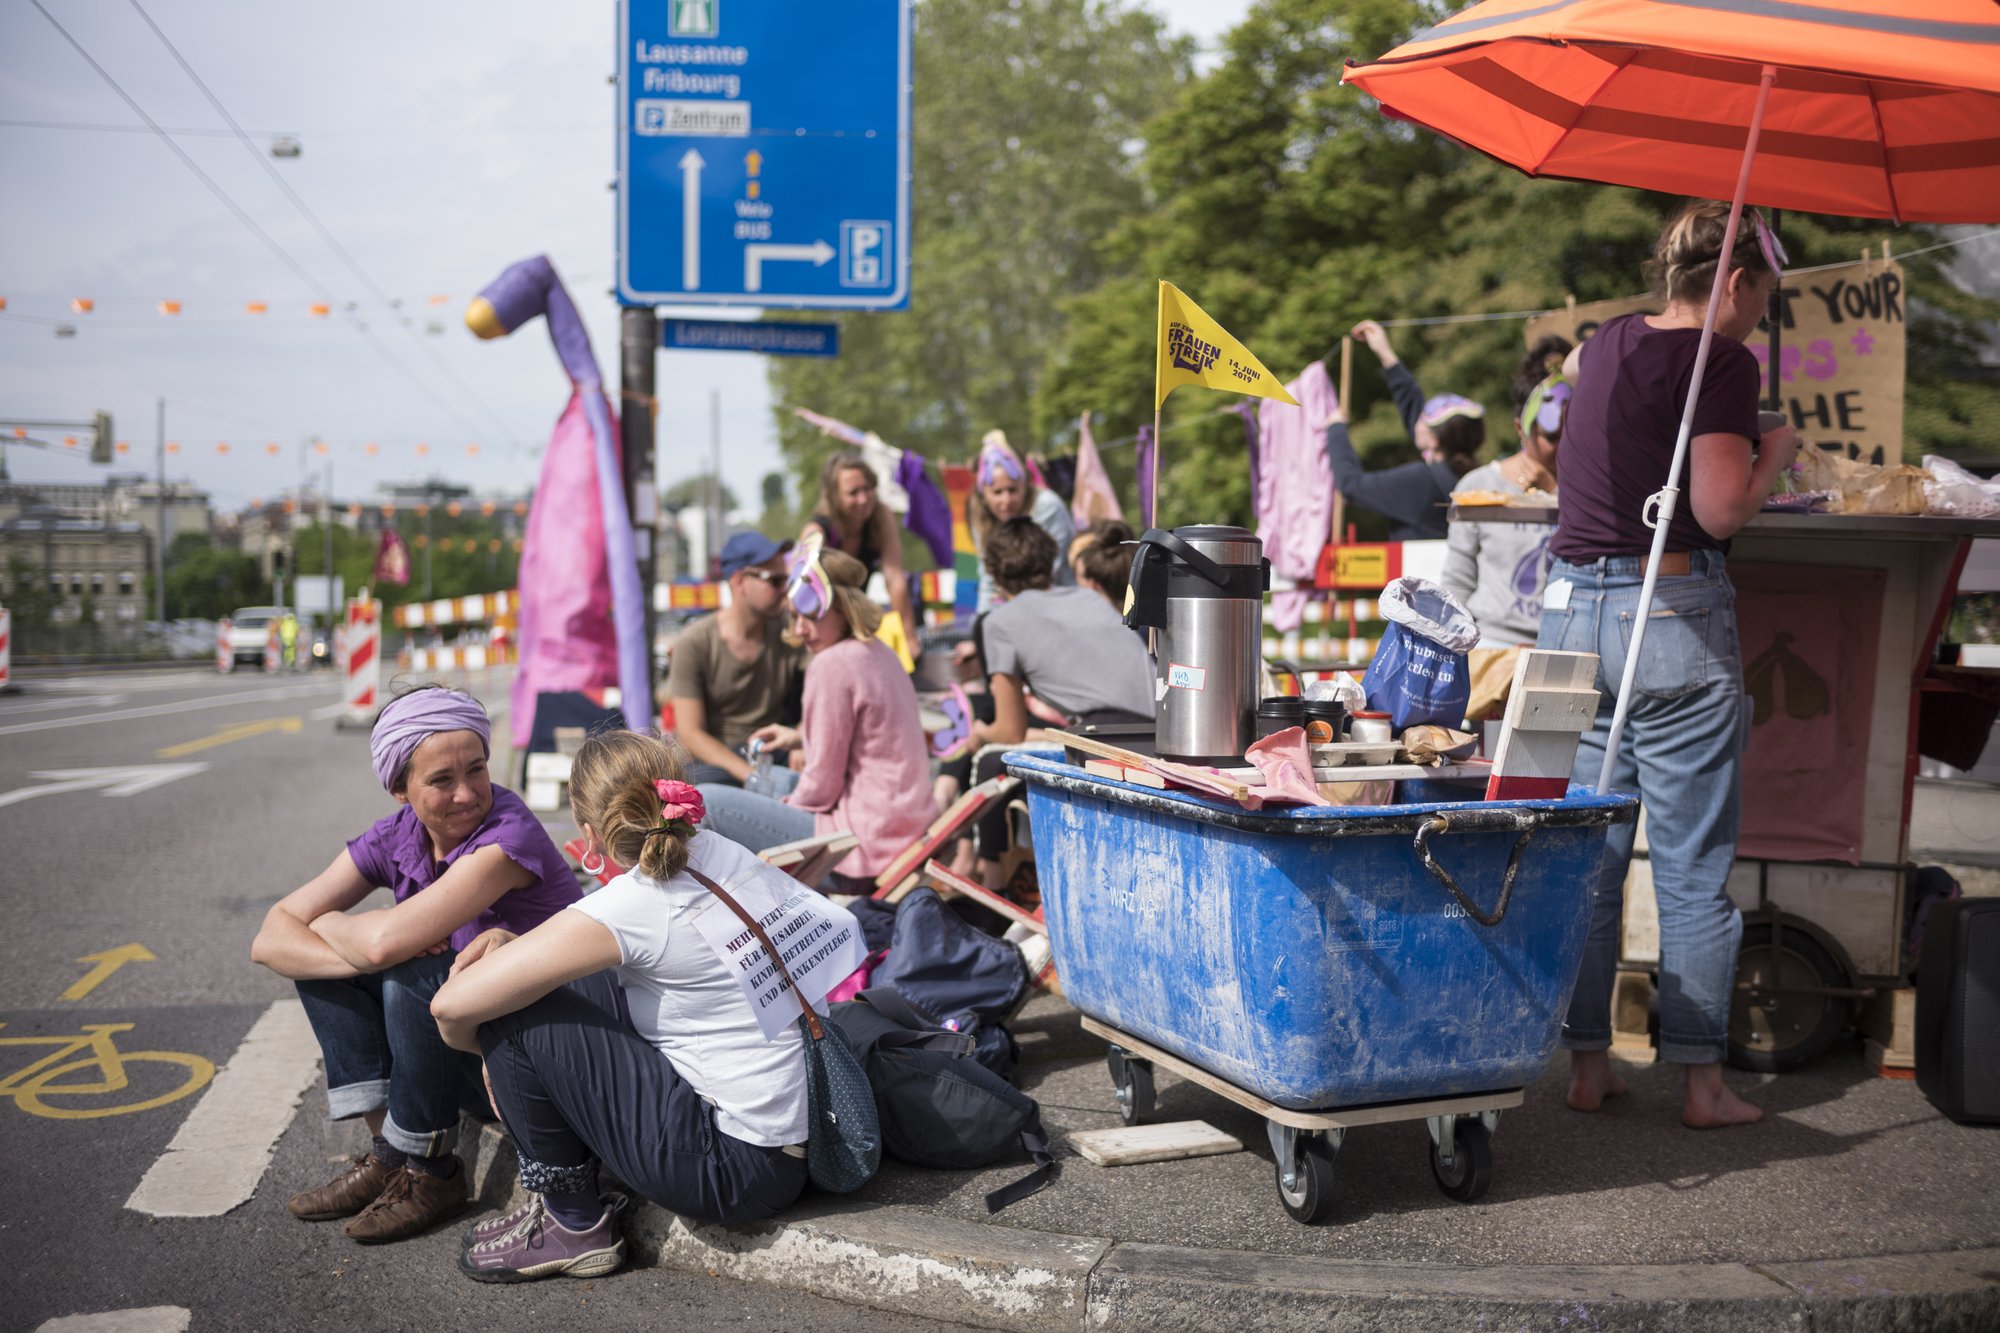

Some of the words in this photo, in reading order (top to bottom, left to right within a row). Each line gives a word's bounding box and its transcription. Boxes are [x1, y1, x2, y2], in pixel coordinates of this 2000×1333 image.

[636, 39, 748, 65] Lausanne
[644, 67, 740, 98] Fribourg
[671, 107, 743, 130] Zentrum
[1810, 271, 1903, 325] YOUR
[1168, 328, 1221, 360] FRAUEN
[1181, 324, 1194, 334] ZUM
[1169, 342, 1215, 372] STREIK
[1229, 358, 1241, 370] 14.
[1242, 366, 1261, 380] JUNI
[1232, 369, 1253, 383] 2019
[739, 950, 761, 972] FÜR
[760, 909, 817, 956] HUSARBEIT,
[759, 986, 779, 1009] UND
[778, 927, 852, 993] KRANKENPFLEGE!
